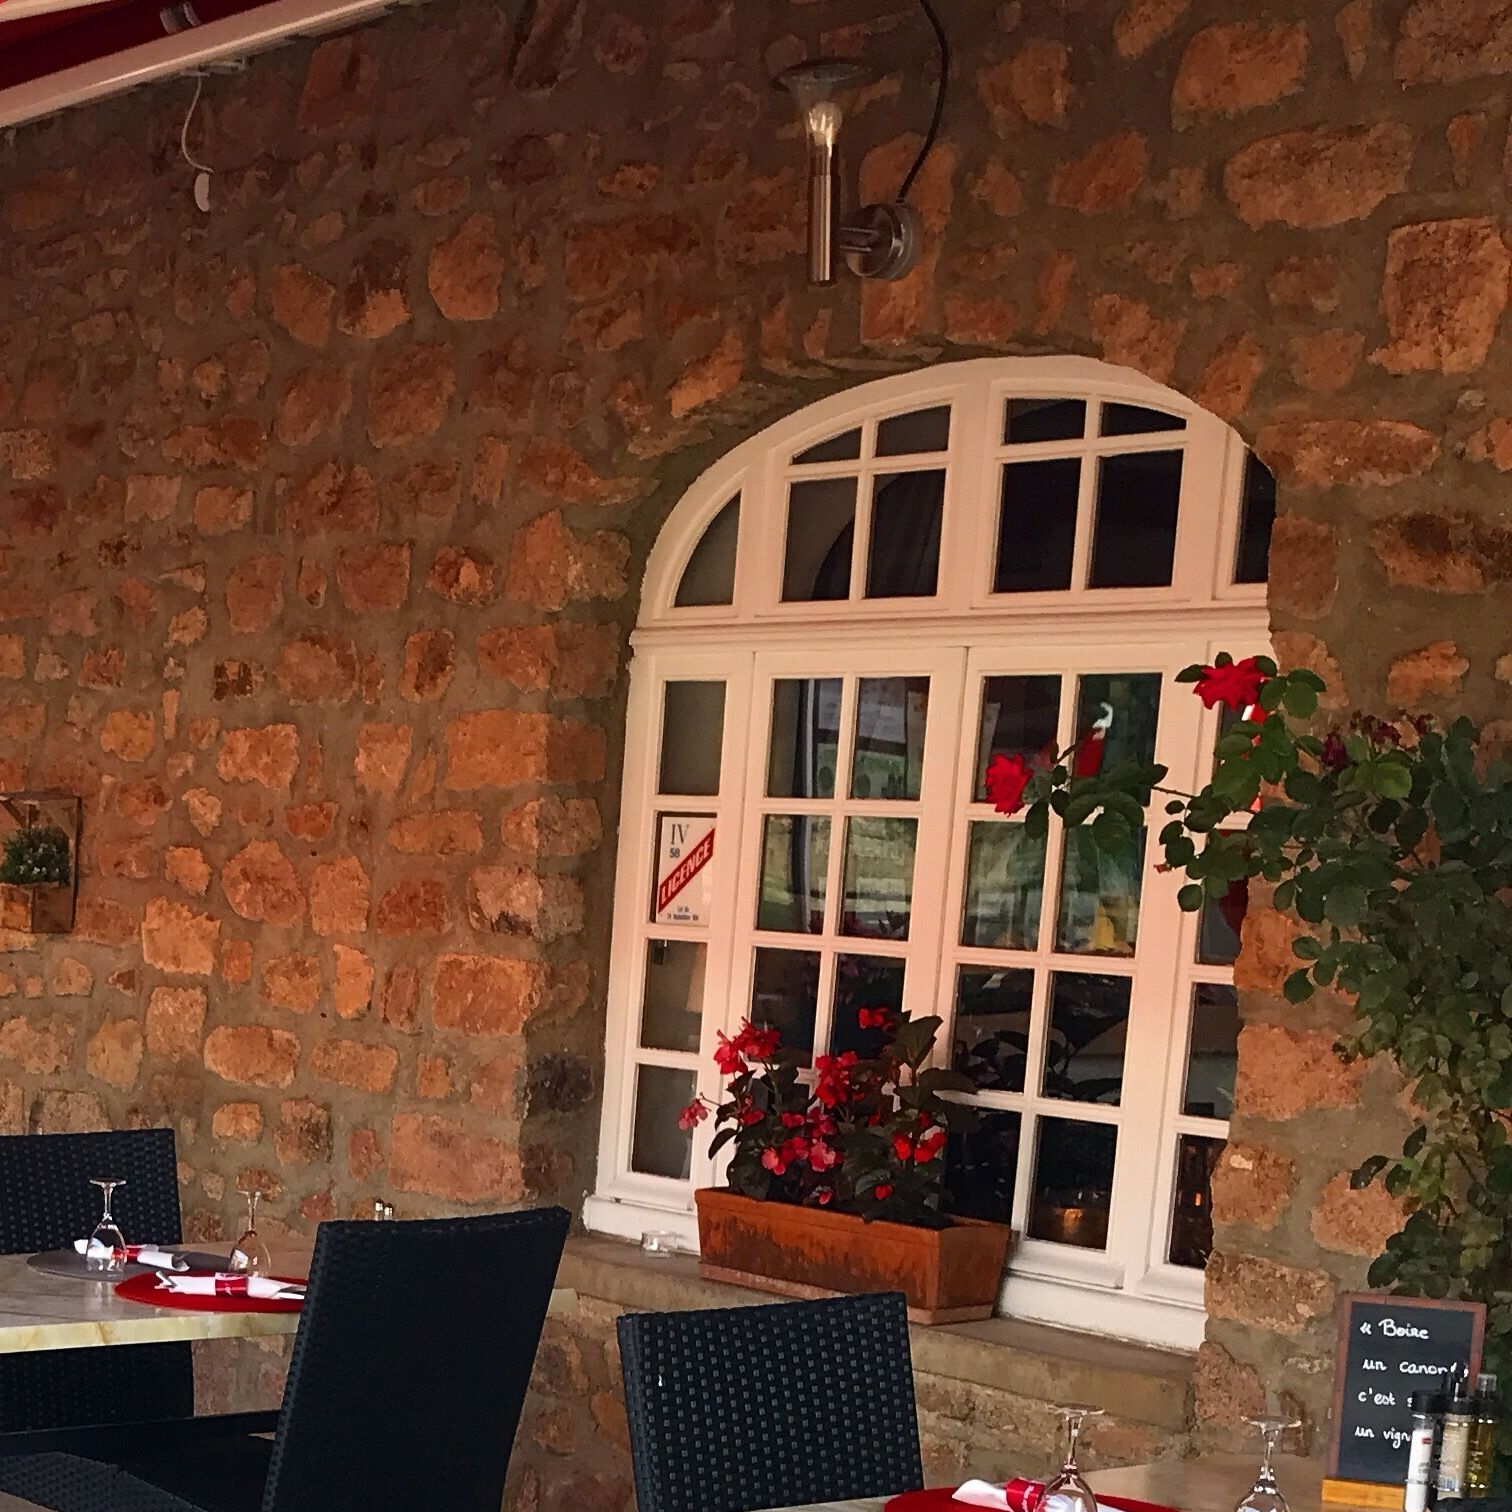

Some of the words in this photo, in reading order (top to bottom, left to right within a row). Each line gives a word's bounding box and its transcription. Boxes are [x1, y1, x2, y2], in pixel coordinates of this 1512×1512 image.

[671, 824, 690, 845] IV
[661, 837, 711, 904] LICENCE
[1378, 1318, 1429, 1340] Boire
[1362, 1358, 1387, 1371] un
[1358, 1387, 1396, 1406] c'est
[1354, 1426, 1375, 1438] un
